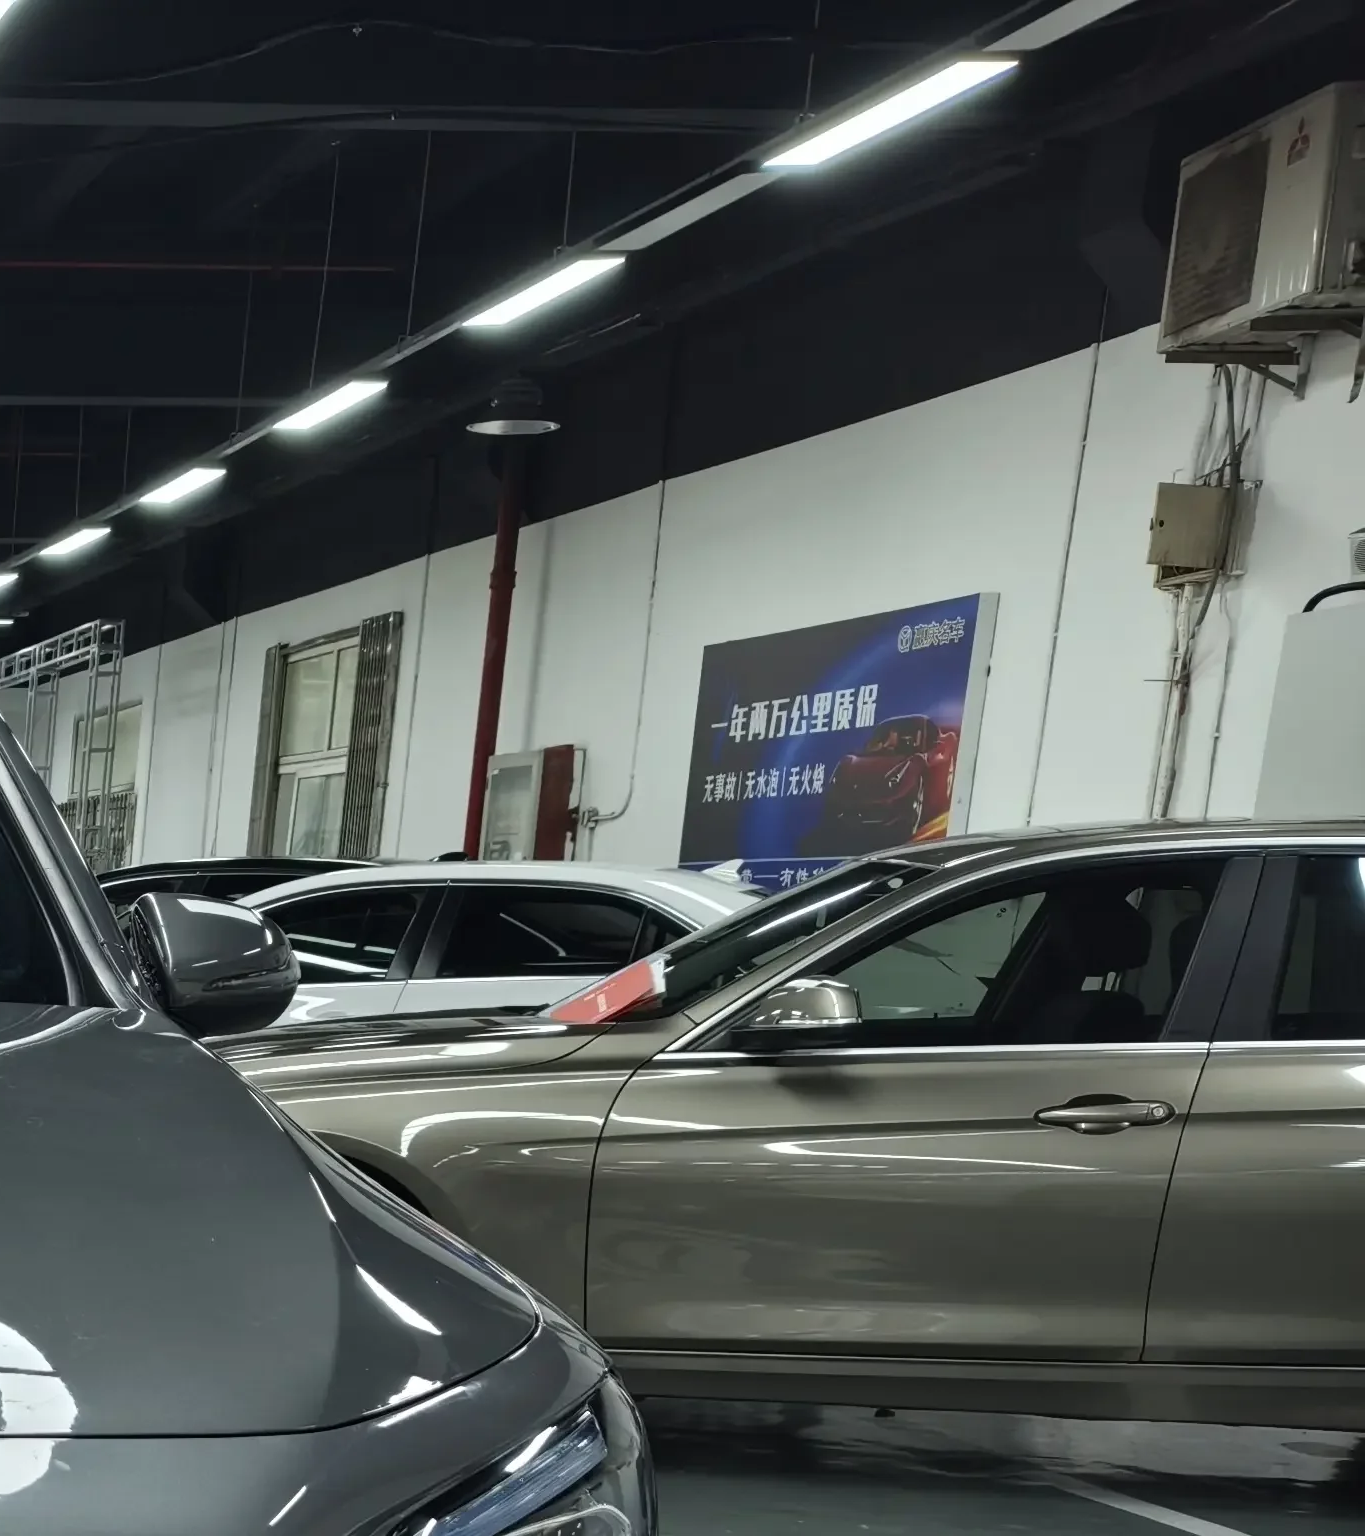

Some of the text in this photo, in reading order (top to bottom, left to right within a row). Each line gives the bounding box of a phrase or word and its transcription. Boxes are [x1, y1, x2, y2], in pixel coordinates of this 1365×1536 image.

[711, 684, 879, 743] 一年两万公里质保
